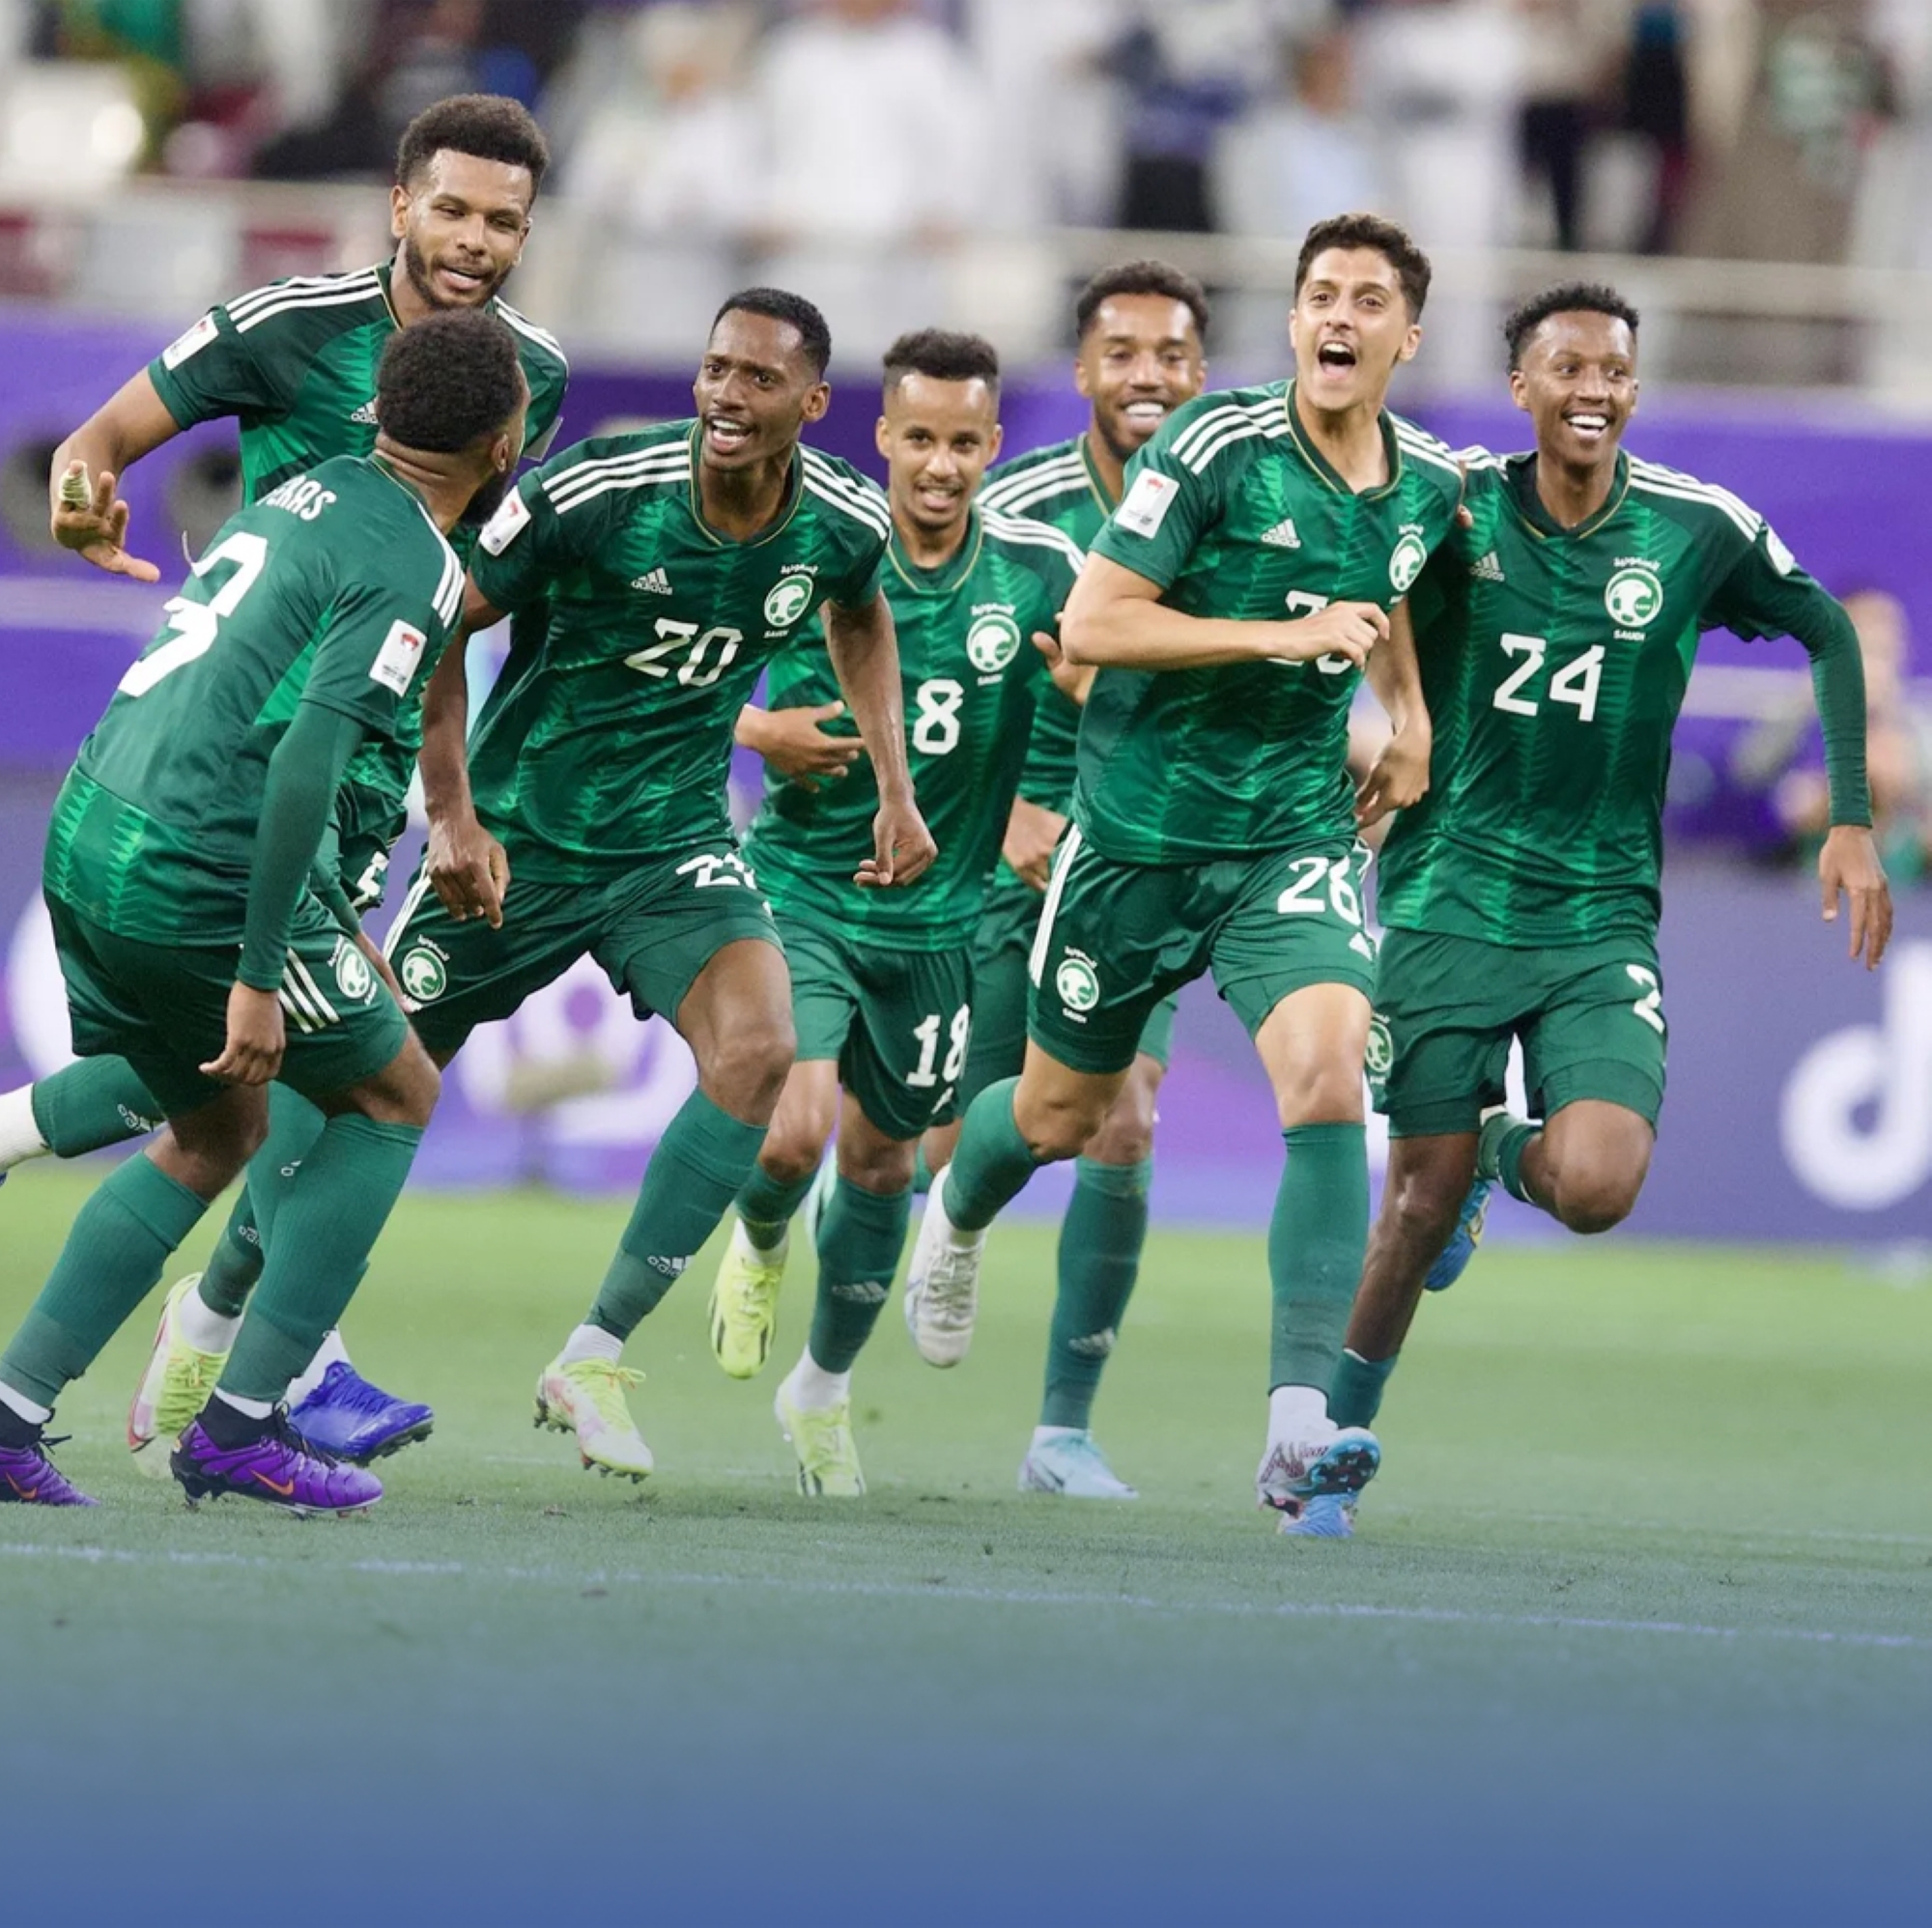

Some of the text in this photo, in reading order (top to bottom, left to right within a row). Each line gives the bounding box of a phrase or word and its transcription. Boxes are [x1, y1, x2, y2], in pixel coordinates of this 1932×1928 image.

[622, 617, 744, 688] 20
[1492, 633, 1605, 723] 24
[912, 678, 965, 754] 8
[1277, 855, 1362, 926] 26
[905, 1003, 971, 1088] 18
